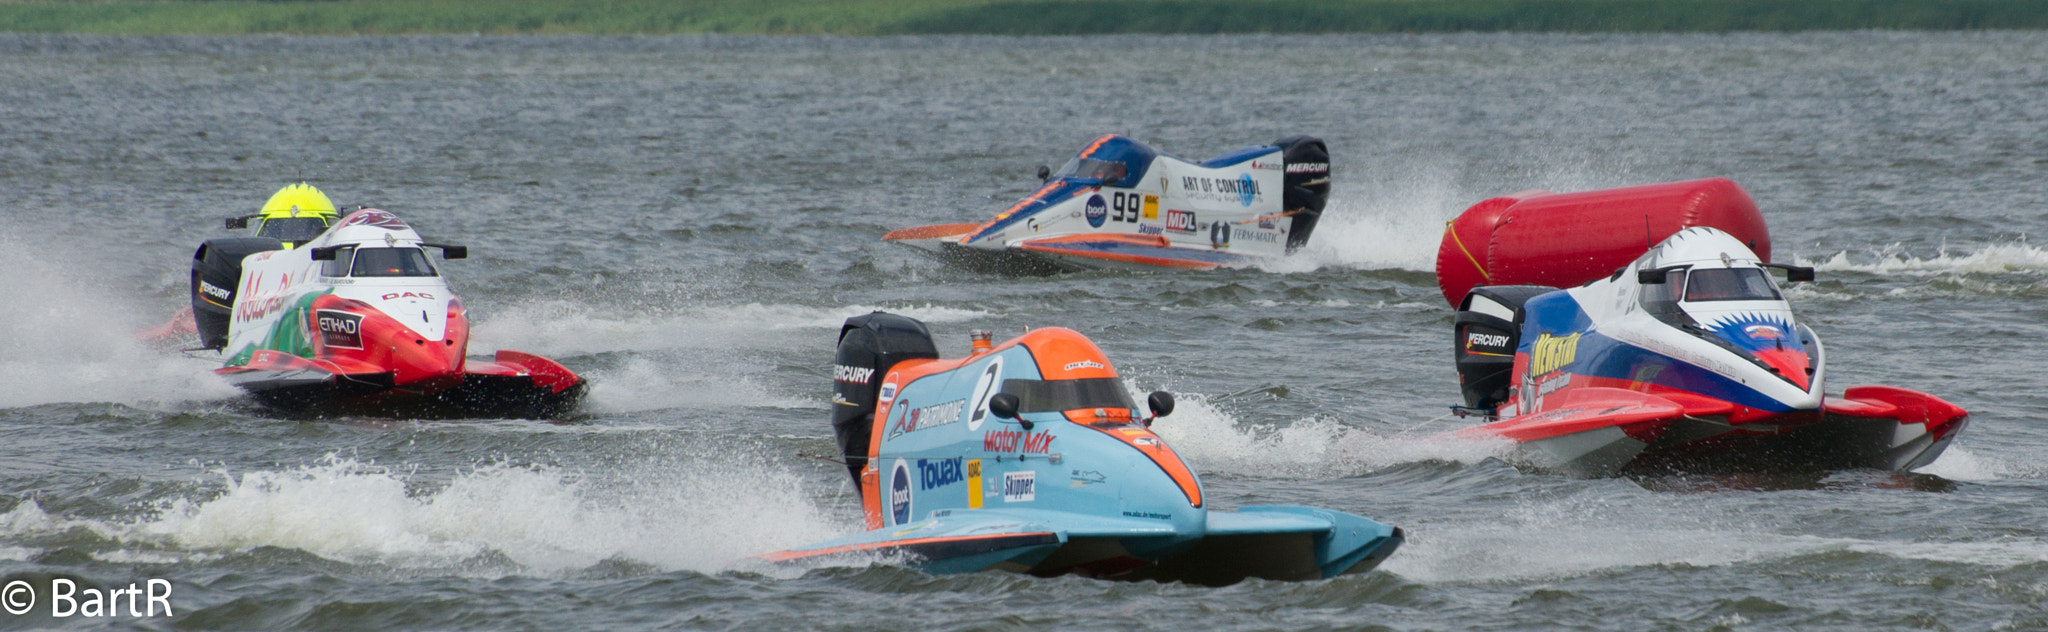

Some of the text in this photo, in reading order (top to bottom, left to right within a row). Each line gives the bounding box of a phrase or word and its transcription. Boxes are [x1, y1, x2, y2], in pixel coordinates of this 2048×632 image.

[1286, 162, 1329, 174] MERCURY
[1182, 176, 1261, 195] ART OF CONTROL
[1092, 204, 1105, 214] boot
[1112, 191, 1140, 223] 99
[1138, 222, 1164, 236] Skipper
[1167, 211, 1195, 231] MDL
[1233, 228, 1278, 244] FERM-MATIC
[199, 279, 231, 300] MERCURY
[382, 291, 435, 301] DAC
[319, 317, 356, 335] ETIHAD
[1468, 332, 1509, 348] MERCURY
[834, 364, 875, 384] ERCURY
[971, 362, 998, 422] 2
[917, 455, 963, 491] Touax
[967, 461, 981, 478] ADAC
[892, 486, 908, 506] boot
